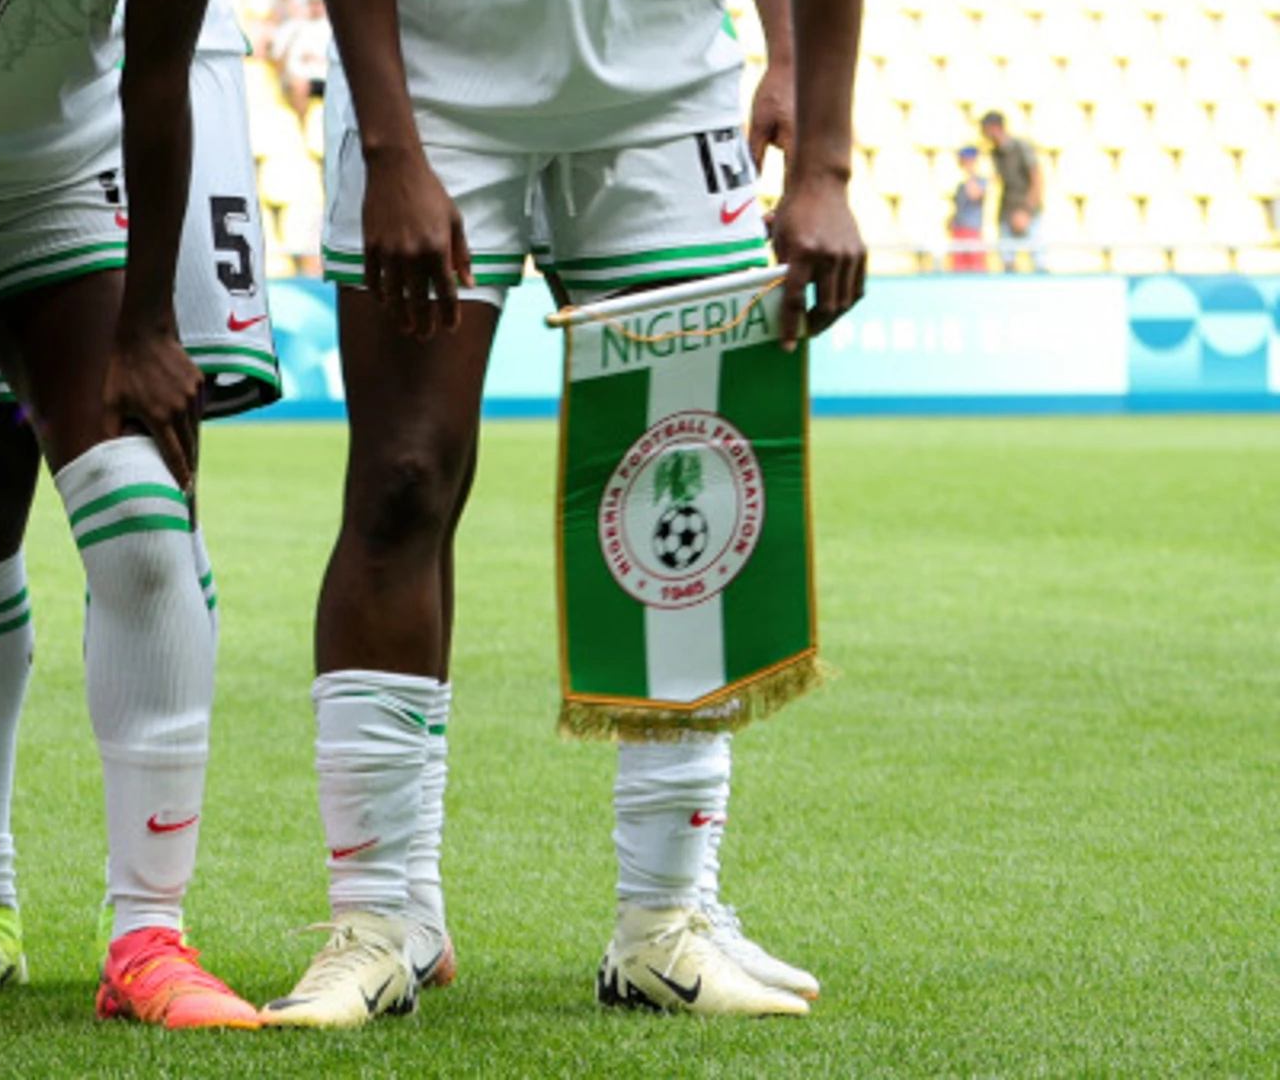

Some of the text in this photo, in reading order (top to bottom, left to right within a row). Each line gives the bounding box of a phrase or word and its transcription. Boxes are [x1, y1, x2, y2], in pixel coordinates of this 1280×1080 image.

[209, 196, 256, 297] 5
[600, 294, 770, 369] NIGERIA
[620, 419, 708, 480] FOOTBALL
